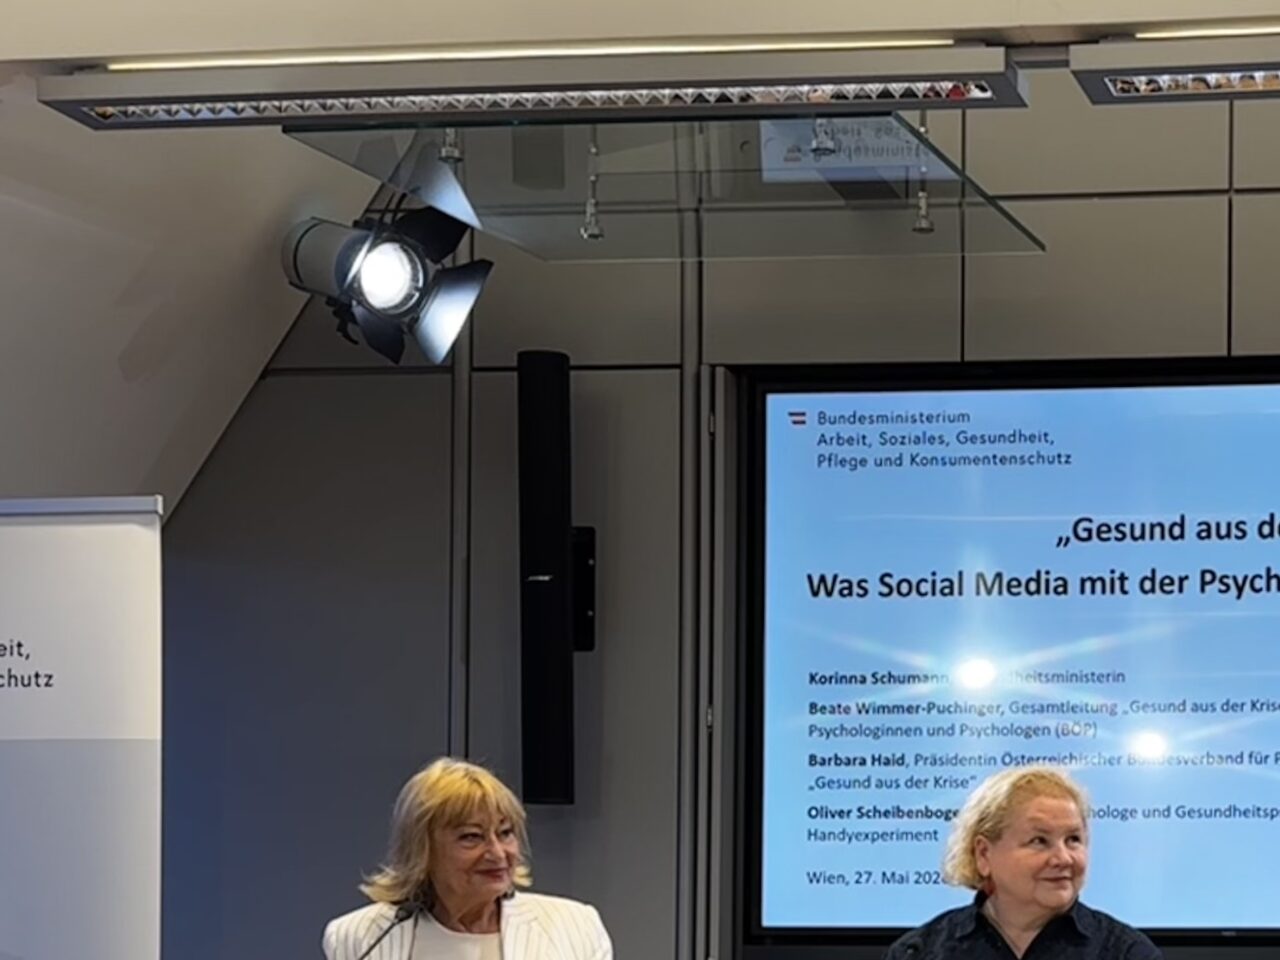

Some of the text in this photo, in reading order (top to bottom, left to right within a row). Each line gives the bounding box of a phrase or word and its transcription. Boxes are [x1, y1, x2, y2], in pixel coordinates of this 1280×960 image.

[817, 410, 971, 425] Bundesministerium
[816, 429, 1056, 448] Arbeit, Soziales, Gesundheit,
[816, 451, 1073, 471] Pflege und Konsumentenschutz
[1055, 514, 1186, 548] „Gesund
[1196, 520, 1248, 541] aus
[806, 573, 869, 598] Was
[878, 571, 964, 597] Social
[974, 570, 1068, 596] Media
[1079, 570, 1129, 595] mit
[1139, 568, 1189, 594] der
[808, 670, 1126, 685] Korinna Schumann heitsministerin
[808, 702, 851, 715] Beate
[856, 701, 1005, 717] Wimmer-Puchinger,
[1008, 700, 1118, 717] Gesamtleitung
[1190, 702, 1217, 713] aus
[1220, 699, 1246, 713] der
[808, 721, 1098, 740] Psychologinnen und Psychologen (BÖP)
[808, 753, 867, 767] Barbara
[871, 753, 910, 768] Haid,
[914, 753, 997, 767] Präsidentin
[1001, 752, 1122, 767] Österreichischer
[1127, 751, 1244, 766] Besverband
[1248, 751, 1270, 765] für
[875, 778, 900, 790] aus
[904, 775, 929, 789] der
[807, 806, 852, 819] Oliver
[856, 805, 960, 822] Scheibenboge
[1087, 805, 1138, 821] hologe
[1142, 805, 1171, 819] und
[807, 829, 939, 845] Handyexperiment
[806, 871, 947, 886] Wien, 27. Mai 202
